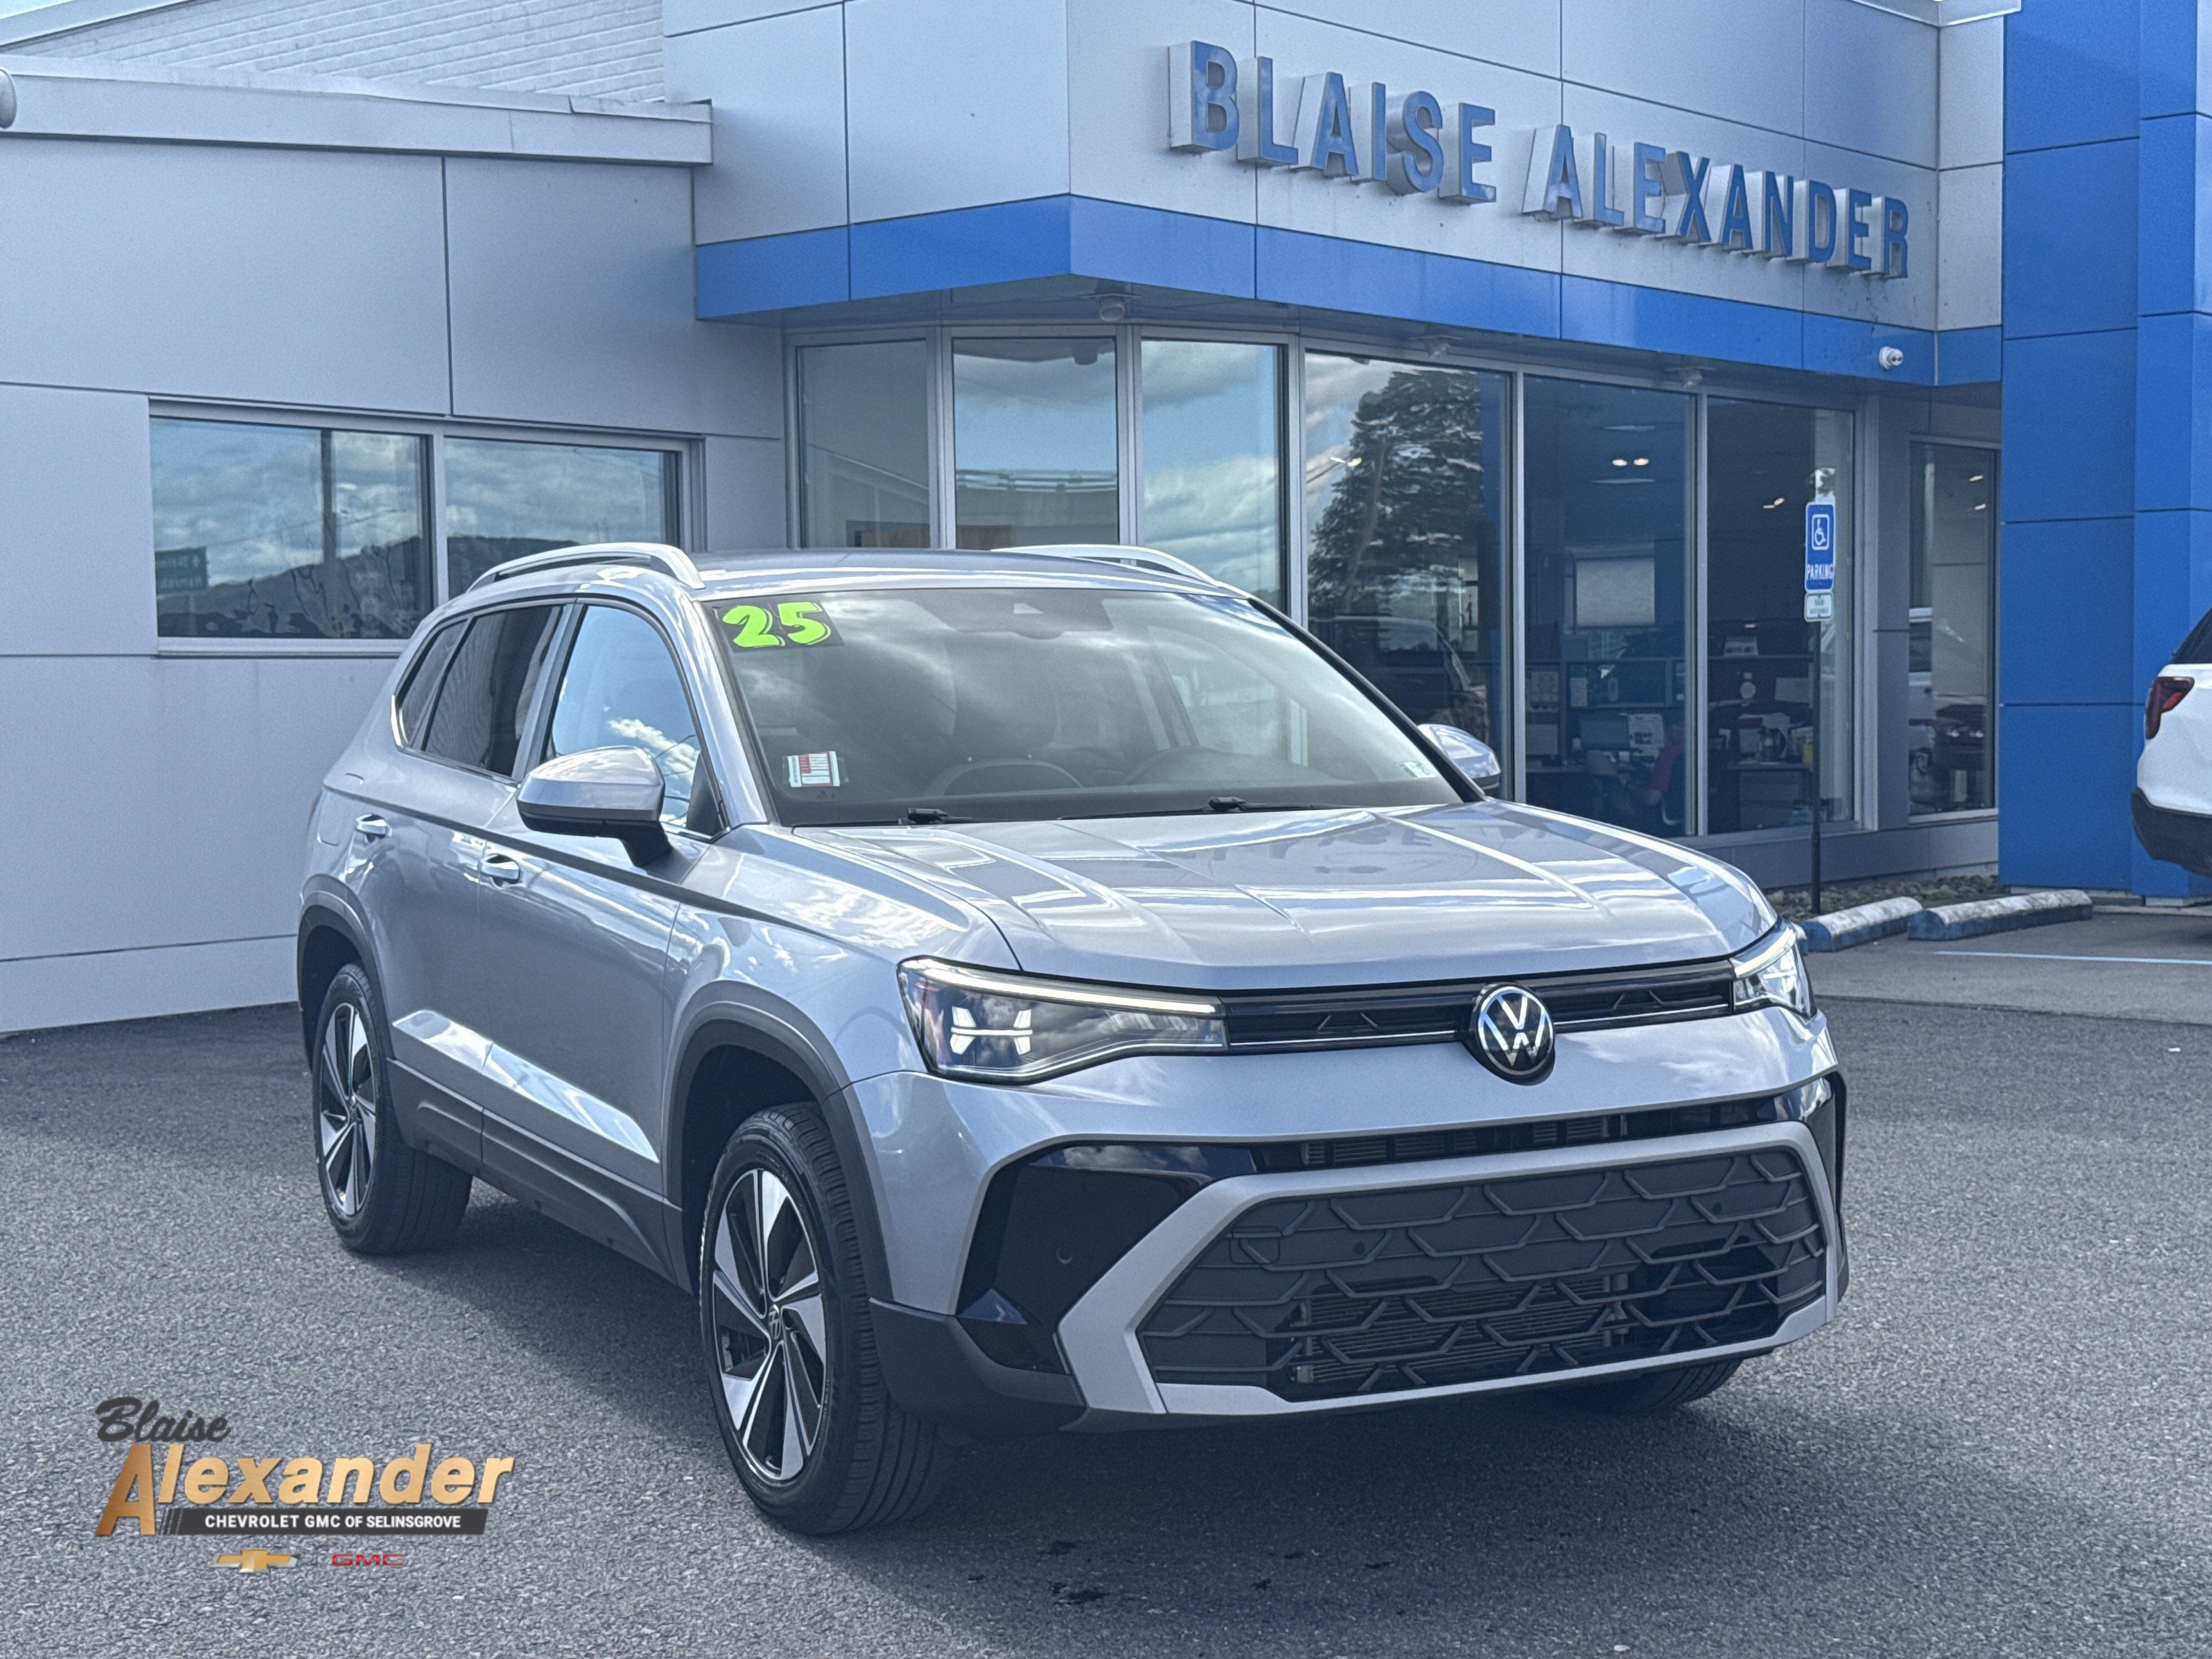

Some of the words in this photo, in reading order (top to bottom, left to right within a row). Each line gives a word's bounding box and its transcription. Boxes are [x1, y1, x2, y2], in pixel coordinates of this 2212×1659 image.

[1170, 41, 1497, 204] BLAISE
[1523, 124, 1909, 279] ALEXANDER
[1807, 563, 1835, 580] PARKING
[722, 601, 831, 648] 25
